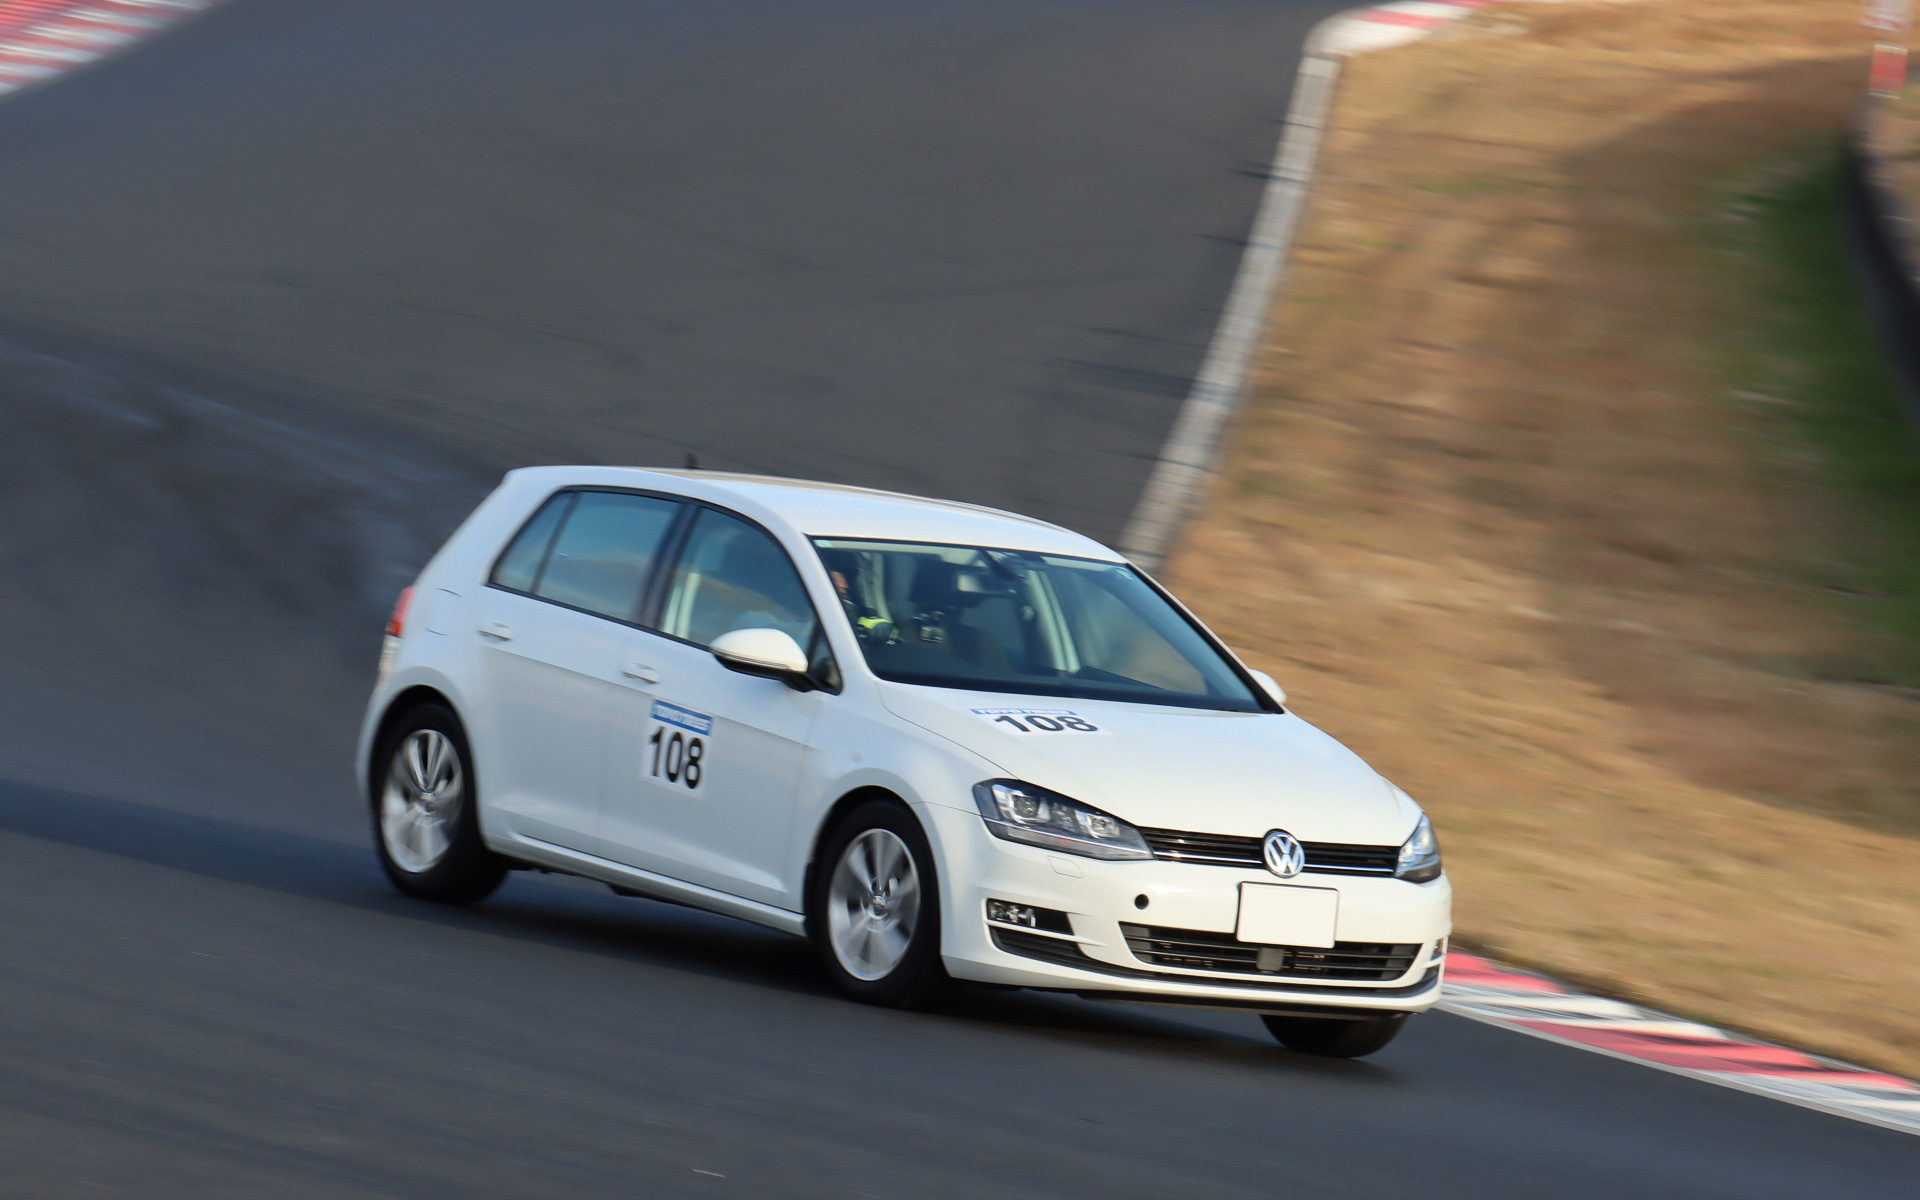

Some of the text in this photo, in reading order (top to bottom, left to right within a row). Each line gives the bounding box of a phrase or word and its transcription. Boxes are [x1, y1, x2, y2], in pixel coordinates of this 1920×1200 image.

[994, 715, 1098, 732] 108
[649, 726, 704, 789] 108
[1264, 831, 1305, 876] VW
